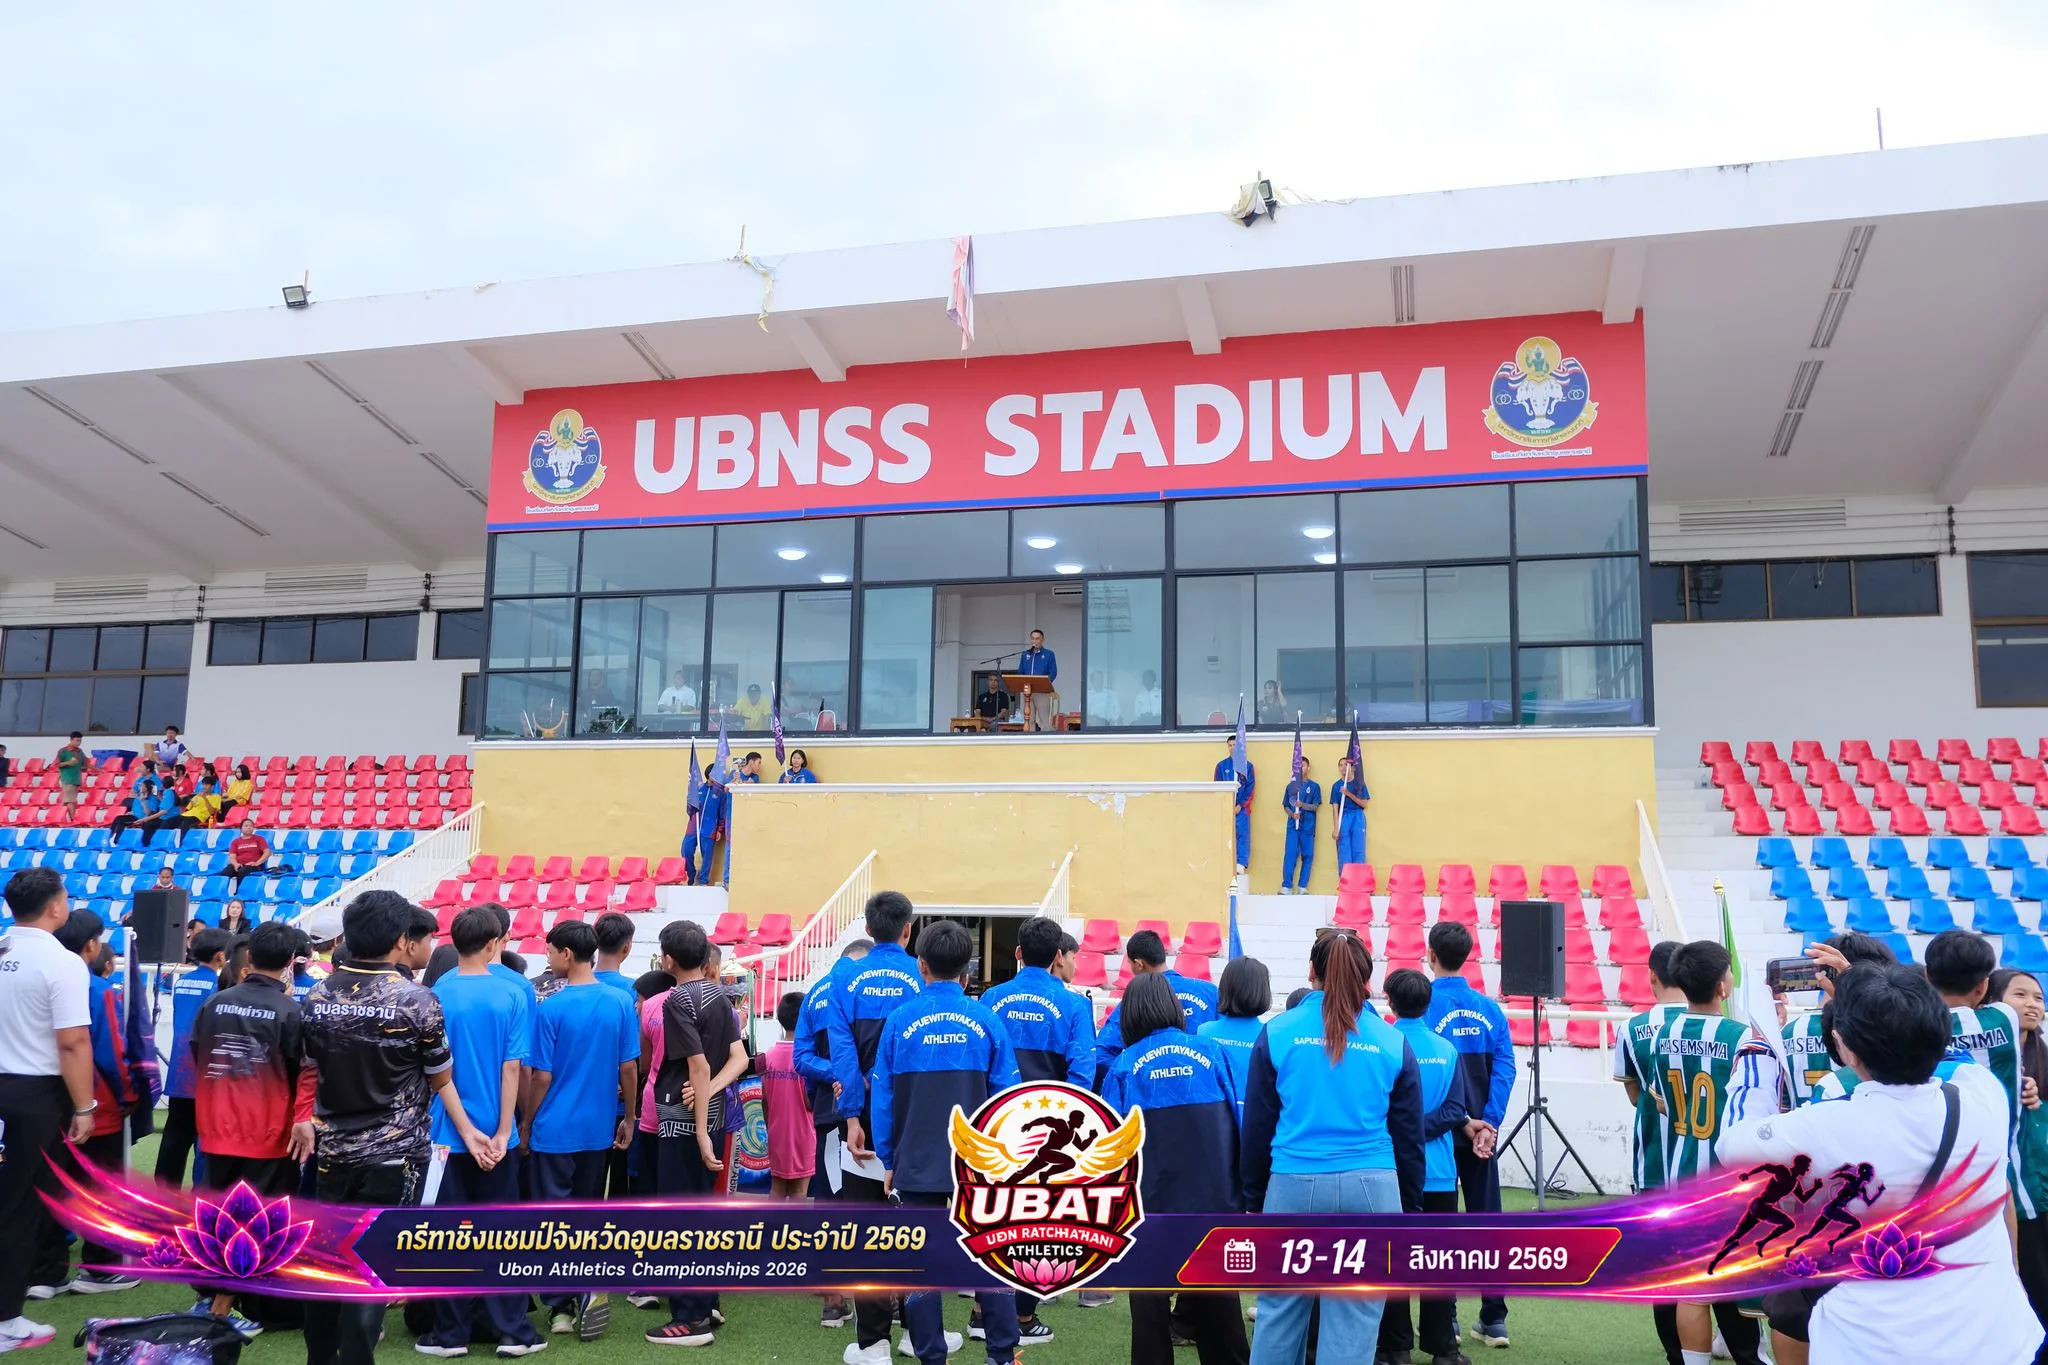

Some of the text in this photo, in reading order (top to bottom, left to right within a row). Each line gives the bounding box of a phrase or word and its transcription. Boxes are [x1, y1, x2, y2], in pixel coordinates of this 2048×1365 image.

[634, 367, 1448, 494] UBNSS STADIUM
[862, 986, 904, 997] ATHLETICS
[314, 1003, 397, 1020] อุบลราชธานี
[991, 993, 1063, 1020] SAPUEWITTAYAKARN
[1007, 1010, 1045, 1022] ATHLETICS
[902, 1012, 986, 1039] SAPUEWITTAYAKARN
[922, 1033, 967, 1045] ATHLETICS
[1659, 1038, 1729, 1061] KASEMSIMA
[1150, 1065, 1193, 1080] ATHLETICS
[1667, 1068, 1716, 1140] 10
